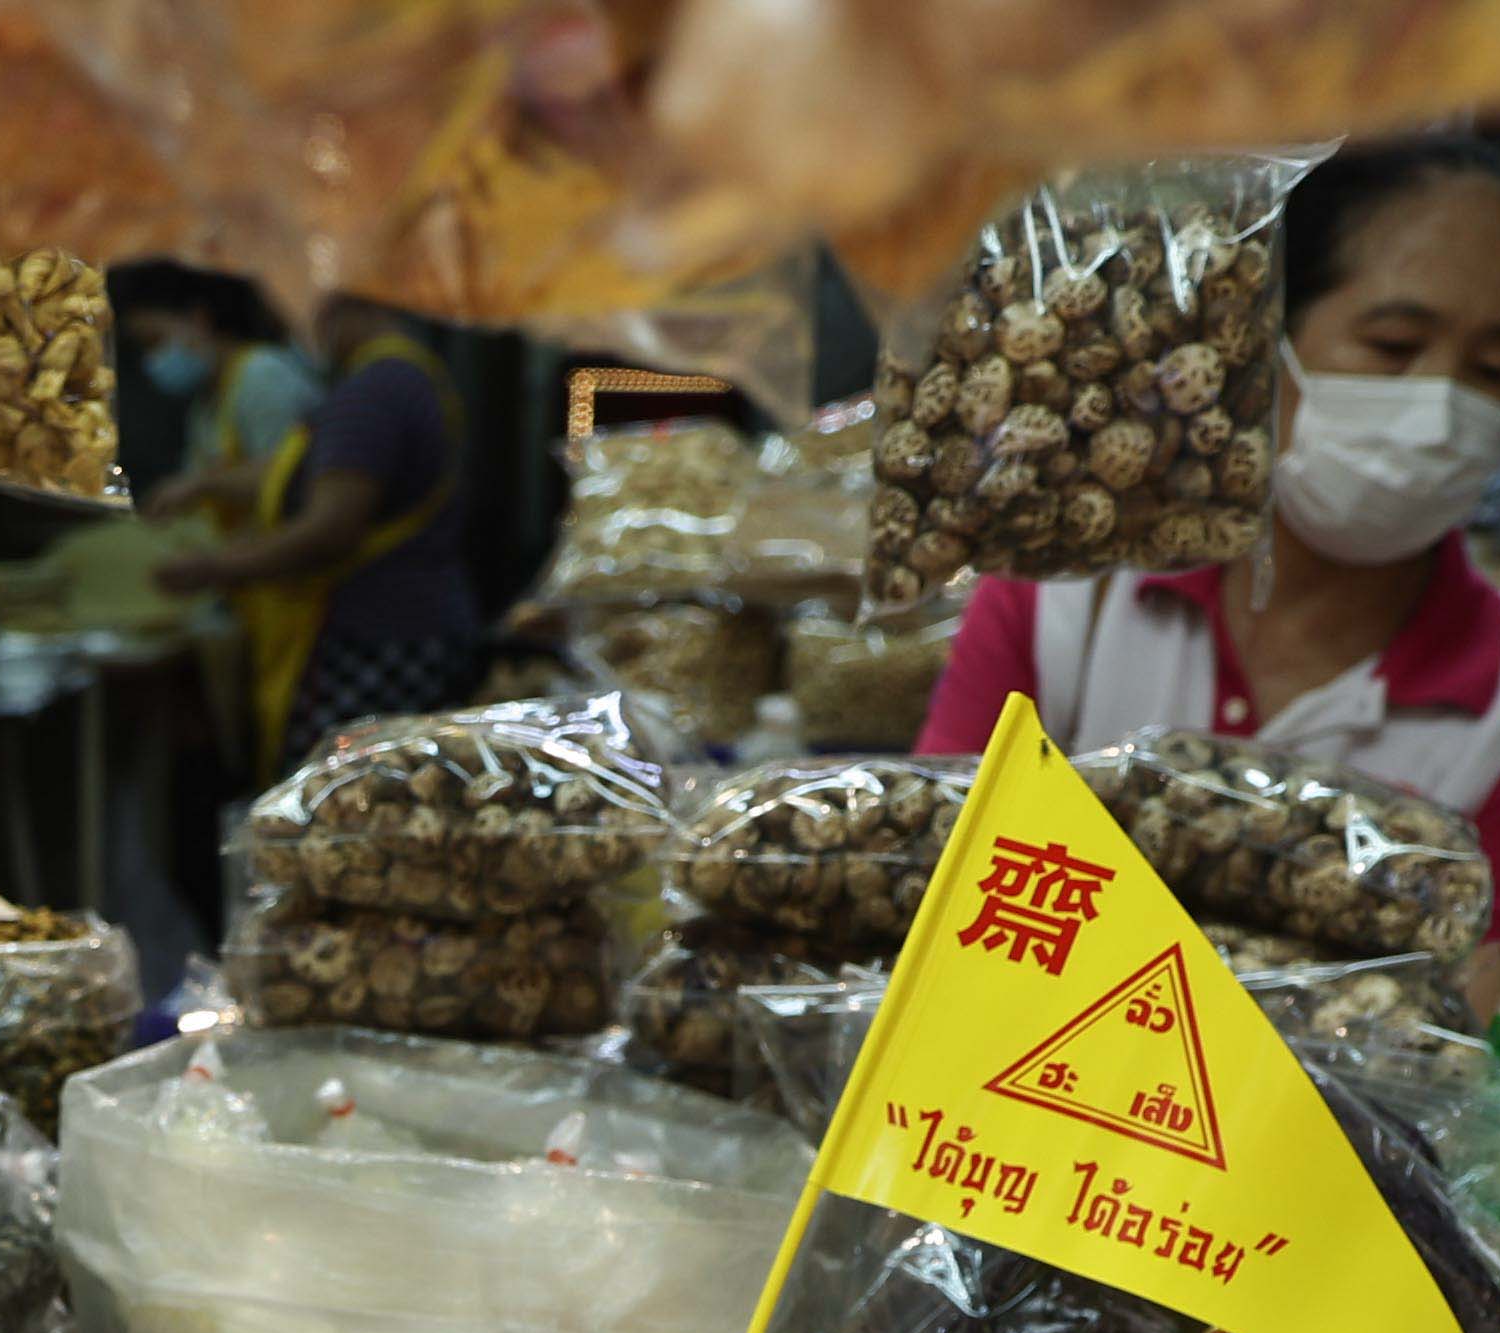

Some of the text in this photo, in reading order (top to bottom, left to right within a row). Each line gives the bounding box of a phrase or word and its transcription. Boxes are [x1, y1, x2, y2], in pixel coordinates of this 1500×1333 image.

[958, 836, 1116, 976] 齋
[1124, 983, 1174, 1036] ฉั่ว
[1038, 1062, 1195, 1134] ฮะ เส็ง
